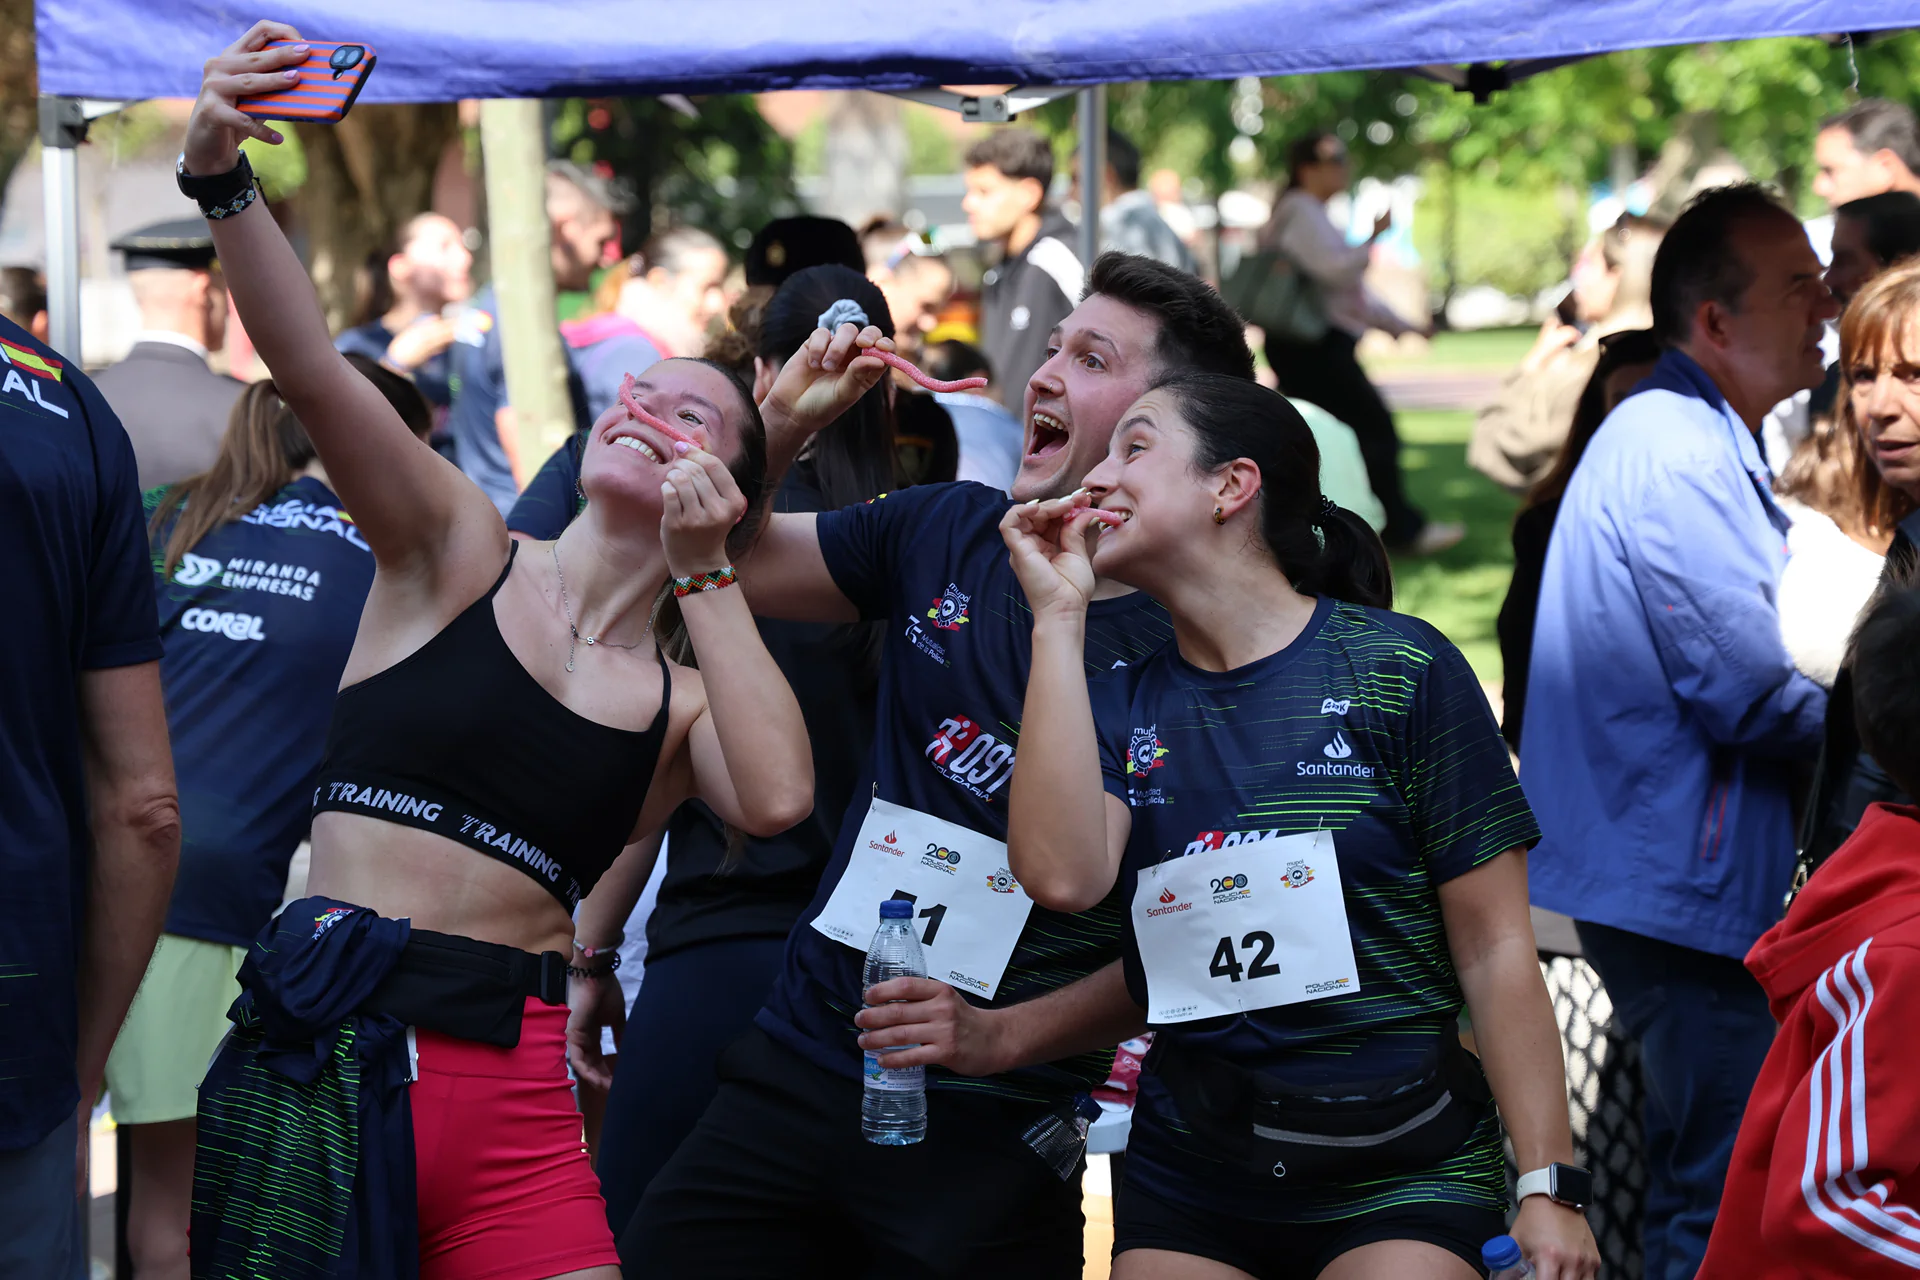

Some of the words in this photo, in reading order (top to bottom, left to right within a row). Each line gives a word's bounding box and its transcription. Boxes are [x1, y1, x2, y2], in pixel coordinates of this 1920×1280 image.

[227, 557, 321, 587] MIRANDA
[221, 570, 315, 601] EMPRESAS
[1296, 761, 1375, 778] Santander
[328, 782, 443, 822] TRAINING
[459, 814, 562, 882] TRAINING
[869, 840, 905, 857] Santander
[925, 843, 961, 865] 200
[921, 860, 955, 876] NACIONAL
[1210, 873, 1248, 894] 200
[1213, 894, 1251, 905] NACIONAL
[889, 889, 948, 947] 1
[1146, 902, 1192, 918] Santander
[1209, 930, 1281, 983] 42
[949, 974, 988, 993] NACIONAL
[1306, 983, 1350, 995] NACIONAL
